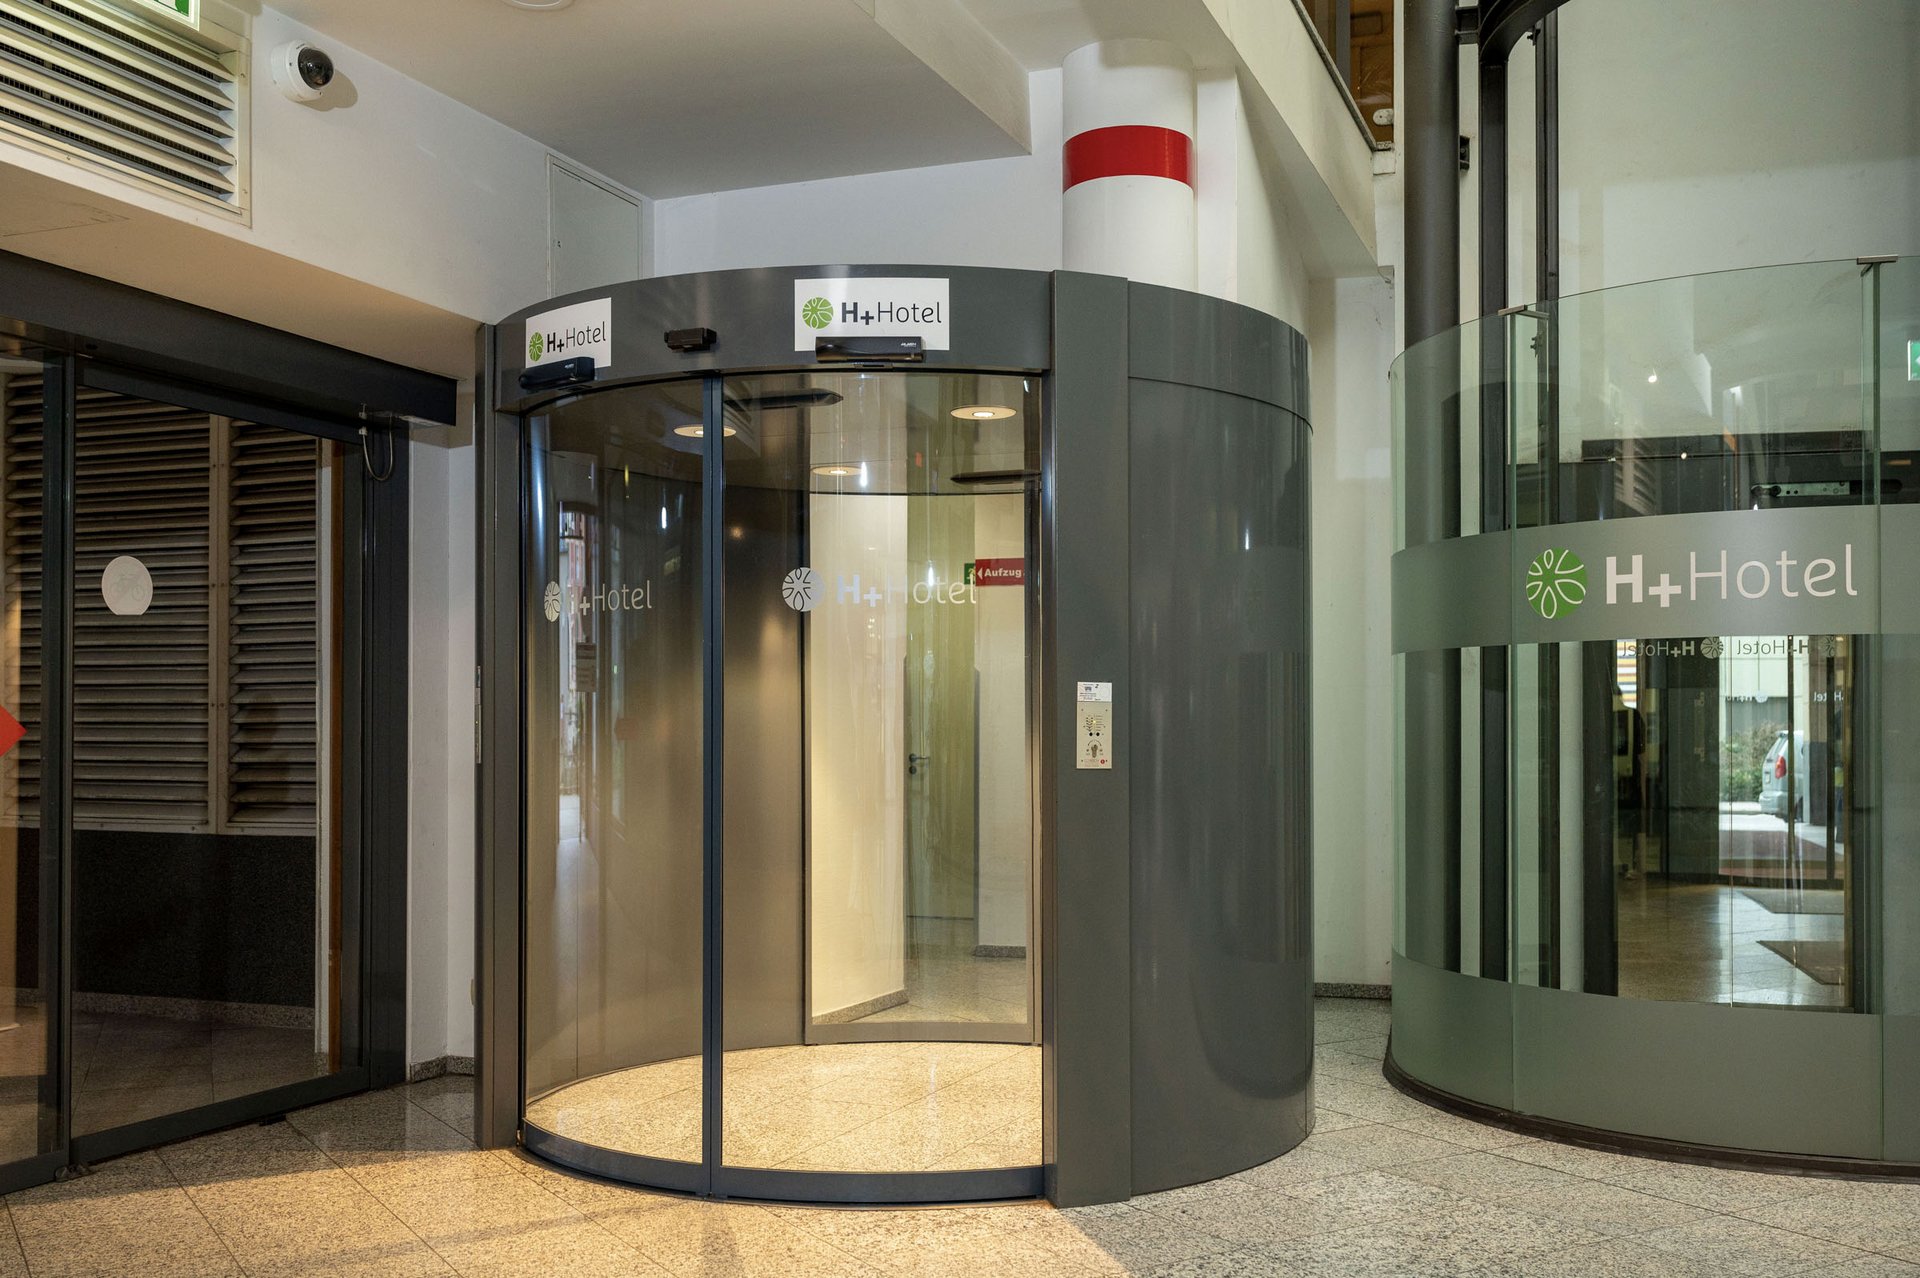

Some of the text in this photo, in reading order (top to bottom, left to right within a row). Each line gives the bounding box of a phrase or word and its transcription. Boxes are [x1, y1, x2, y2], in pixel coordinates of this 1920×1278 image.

[842, 301, 942, 326] H+Hotel
[546, 321, 607, 354] H+Hotel
[984, 567, 1022, 578] Aufzug
[1606, 543, 1858, 608] H+Hotel
[837, 574, 977, 608] H+Hotel
